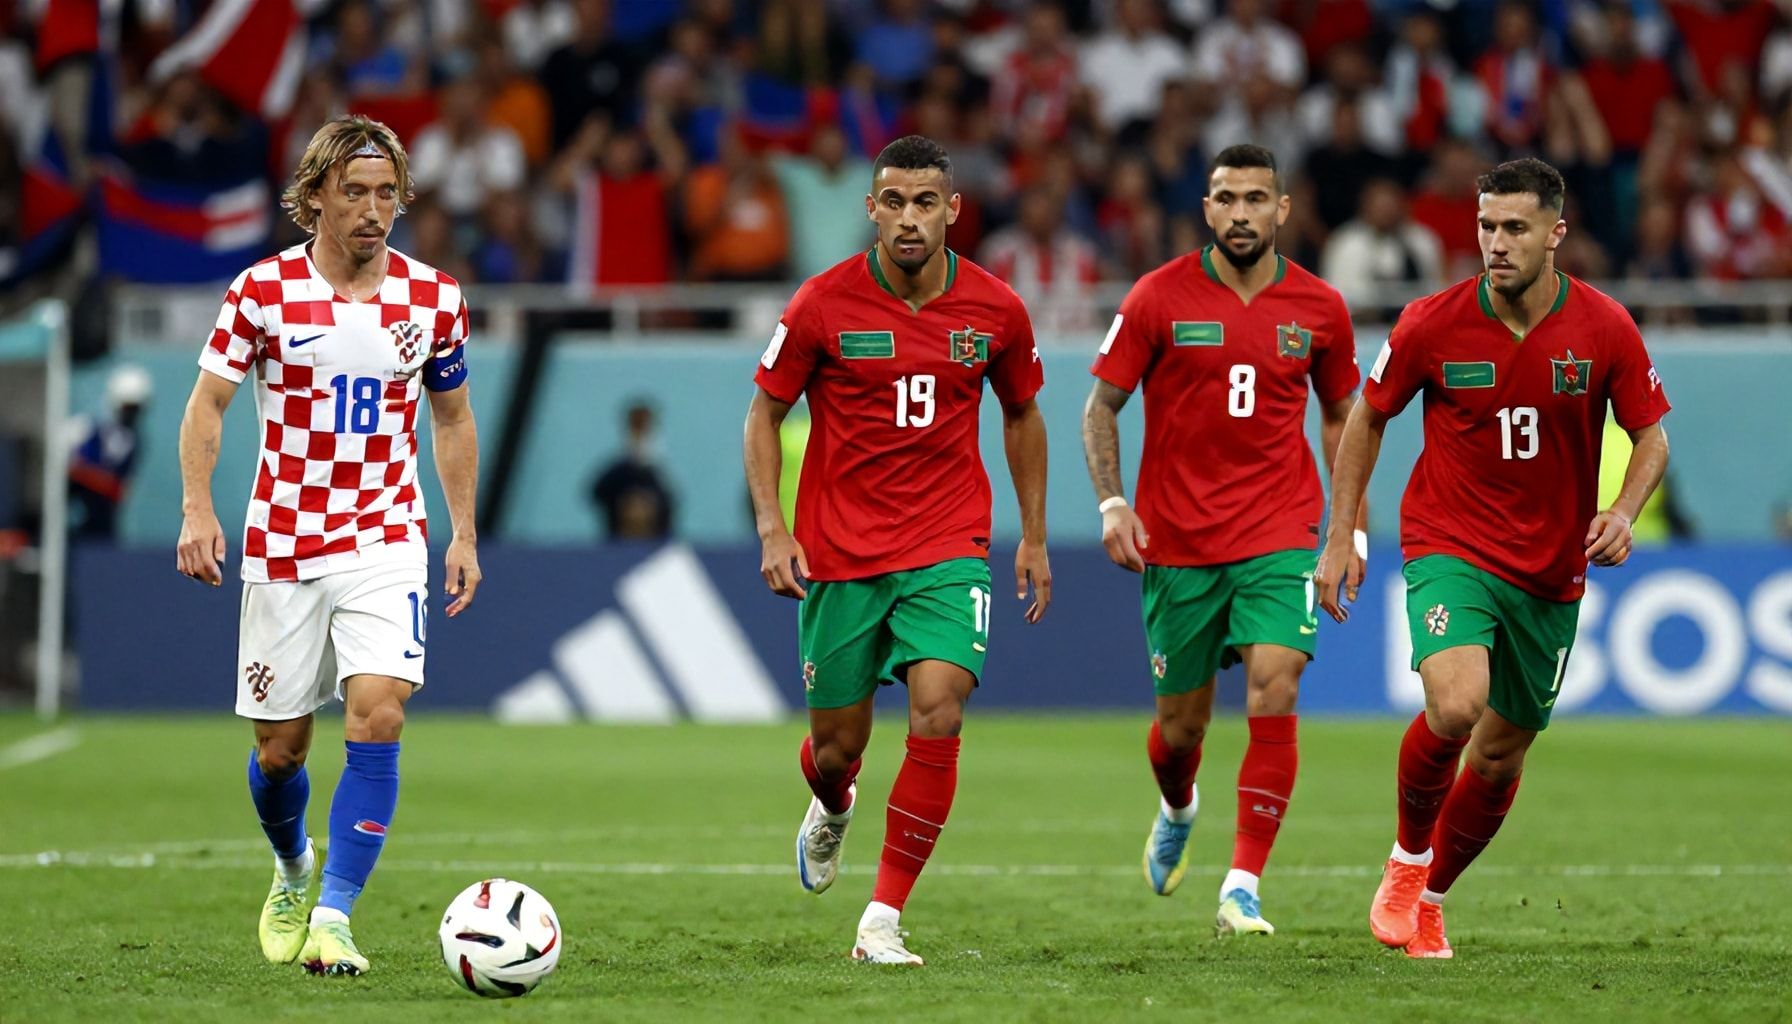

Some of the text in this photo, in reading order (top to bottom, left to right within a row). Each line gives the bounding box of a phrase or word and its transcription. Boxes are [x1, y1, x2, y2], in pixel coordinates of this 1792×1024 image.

[330, 374, 381, 434] 18
[892, 375, 936, 428] 19
[1228, 364, 1256, 418] 8
[1496, 407, 1540, 459] 13
